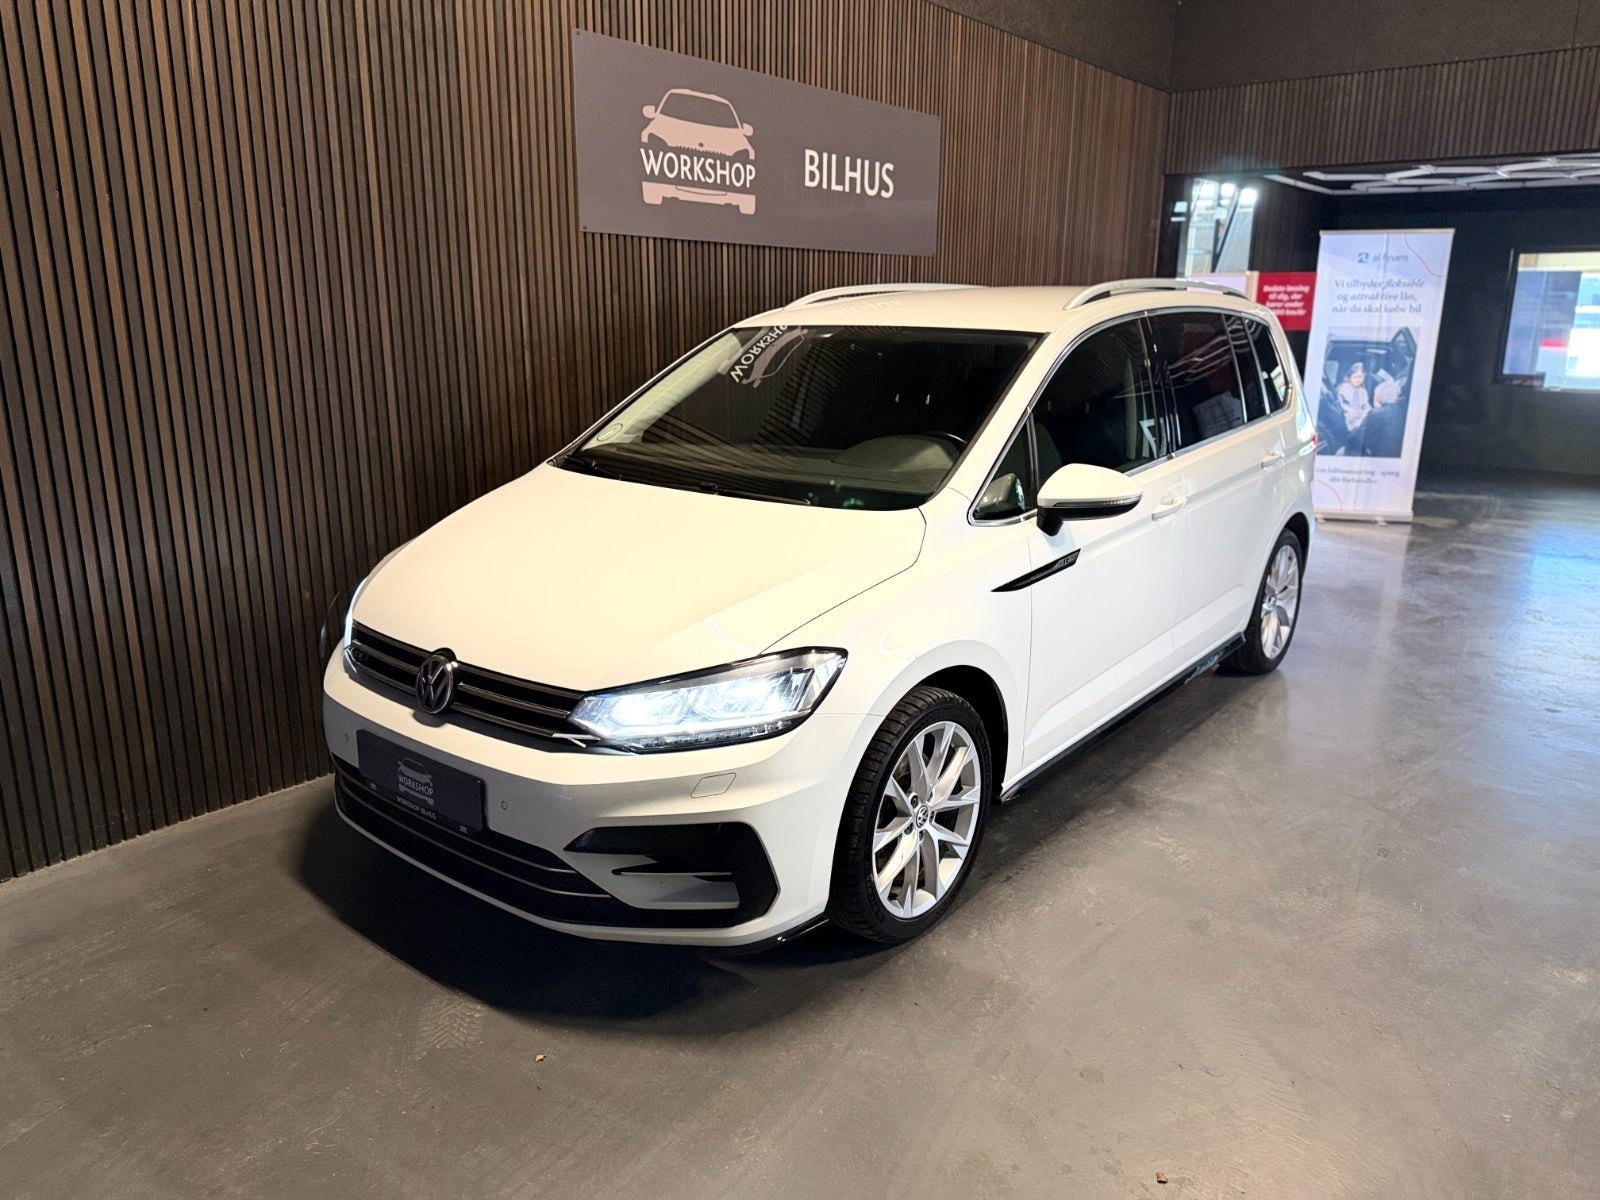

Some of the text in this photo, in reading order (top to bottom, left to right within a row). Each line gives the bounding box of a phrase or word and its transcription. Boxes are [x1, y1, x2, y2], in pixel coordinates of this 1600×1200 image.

[639, 147, 895, 199] WORKSHOP BILHUS
[1335, 280, 1344, 288] Vi
[1346, 279, 1383, 290] tilbyder
[1409, 304, 1422, 313] bil
[398, 774, 434, 796] WORKSHOP
